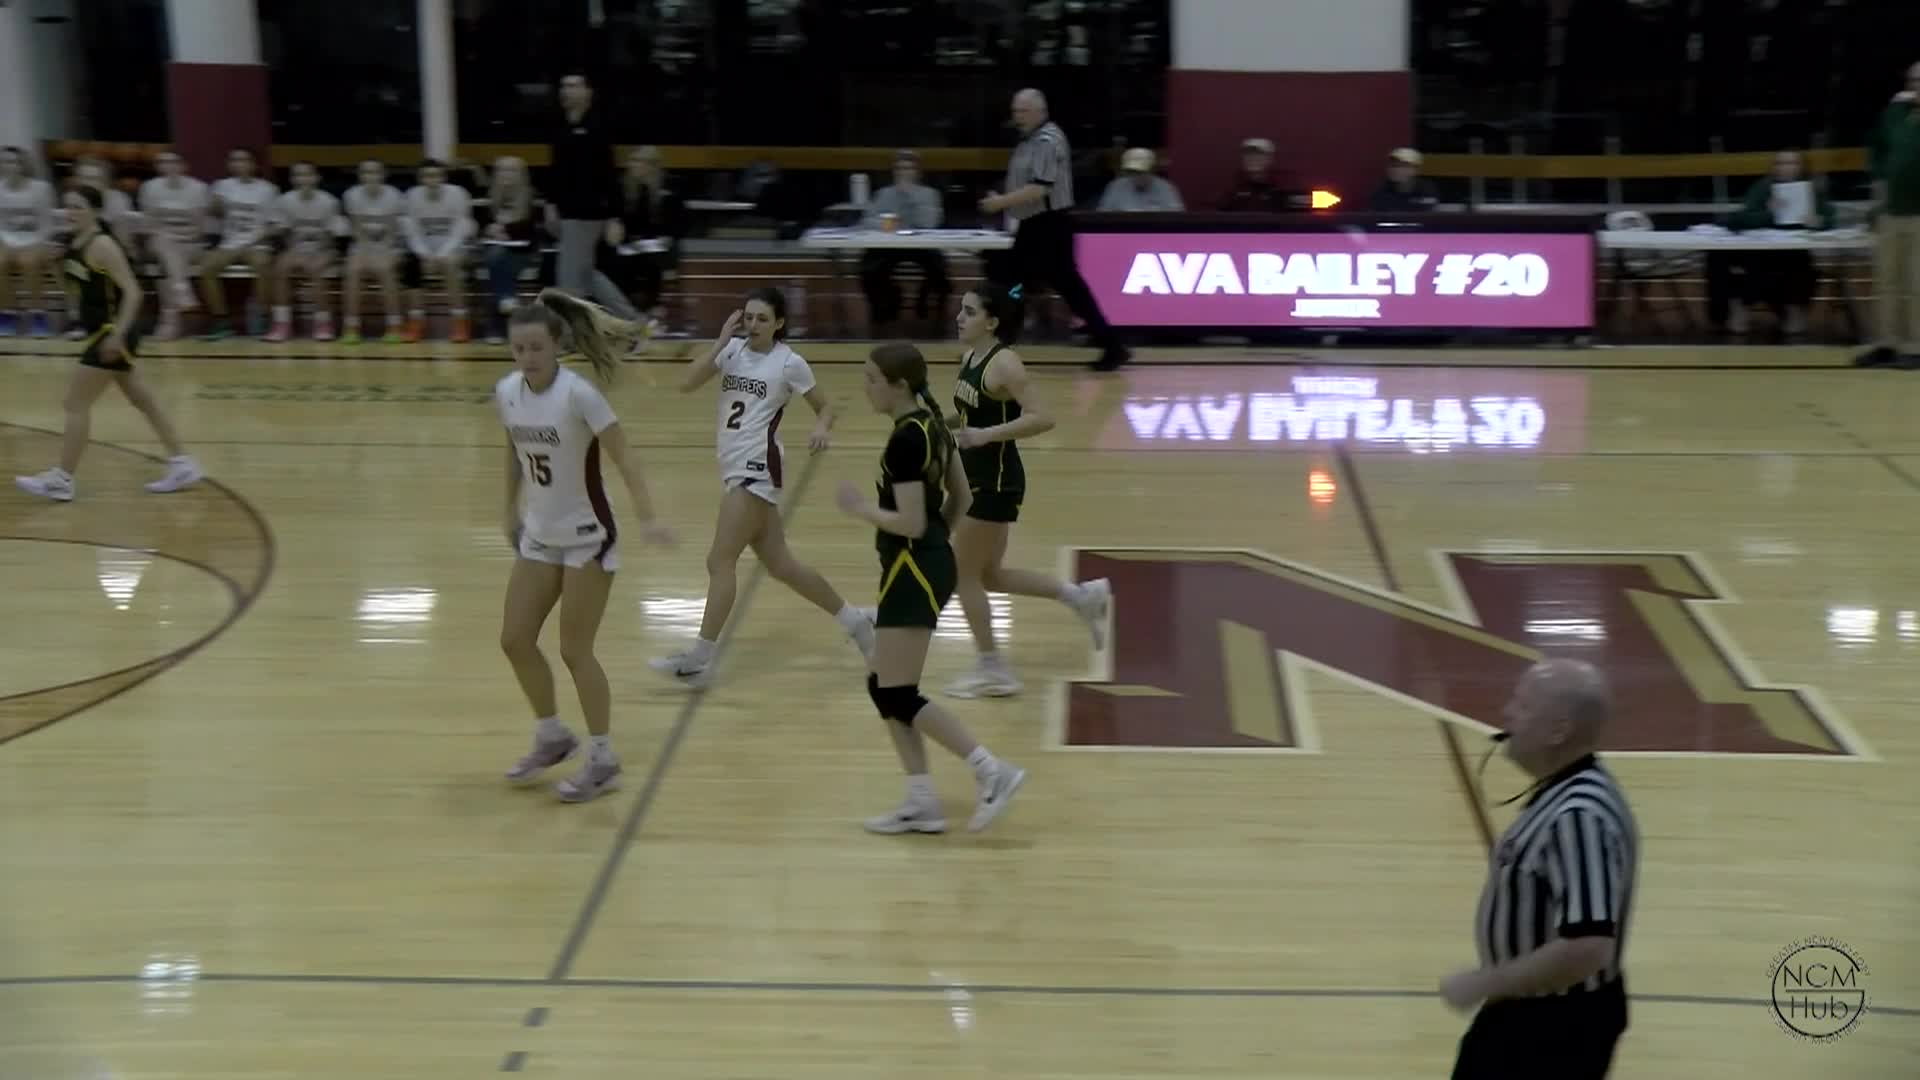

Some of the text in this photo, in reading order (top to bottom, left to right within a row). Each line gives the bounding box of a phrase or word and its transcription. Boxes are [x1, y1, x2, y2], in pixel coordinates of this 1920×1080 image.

[1122, 252, 1550, 296] AVA BAILEY #20
[727, 401, 745, 430] 2
[526, 452, 552, 487] 15
